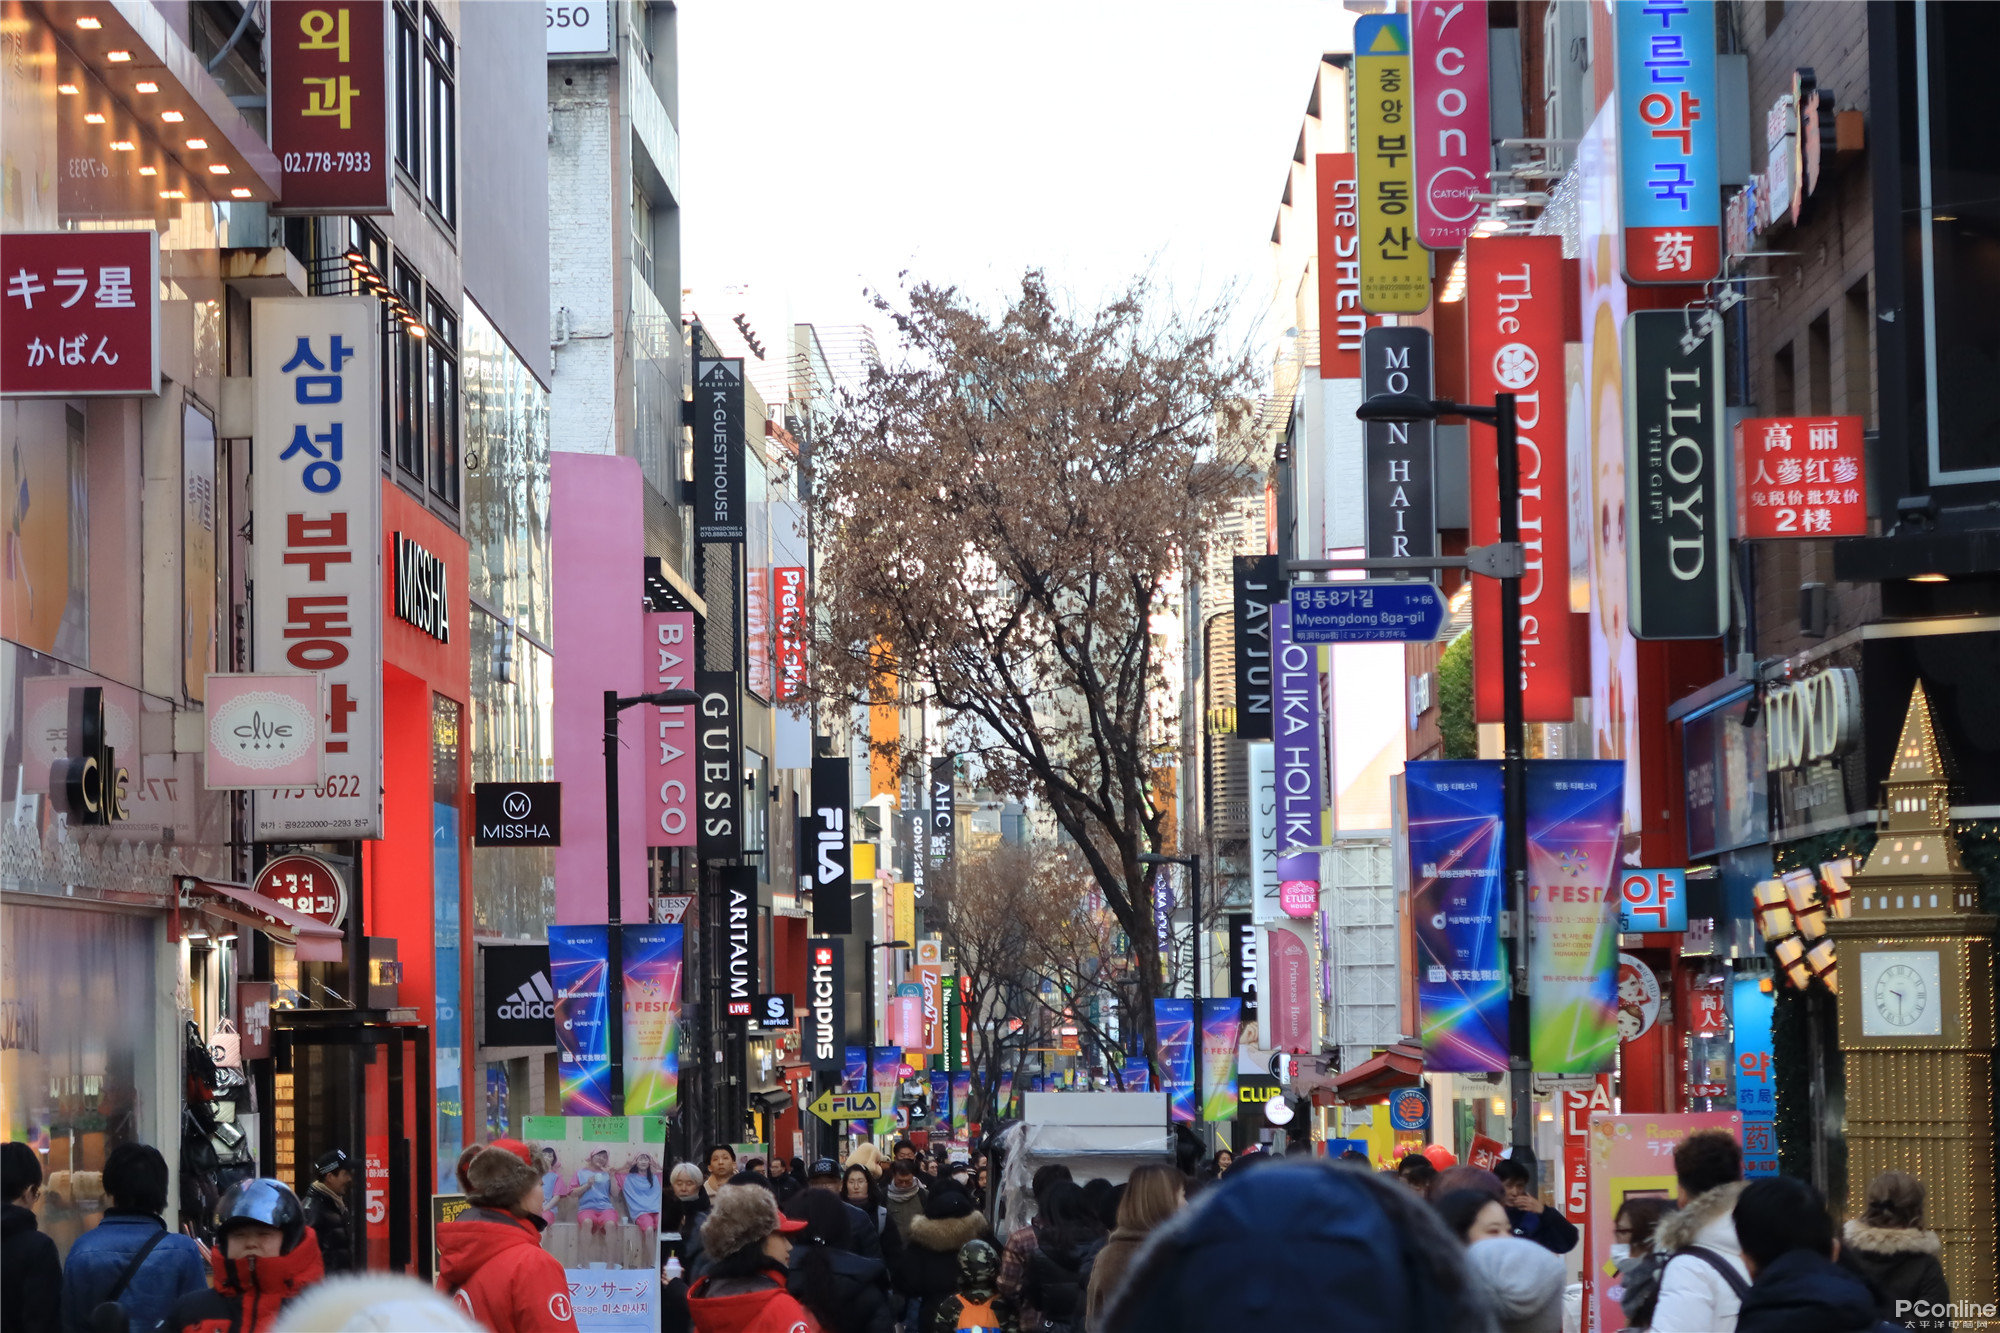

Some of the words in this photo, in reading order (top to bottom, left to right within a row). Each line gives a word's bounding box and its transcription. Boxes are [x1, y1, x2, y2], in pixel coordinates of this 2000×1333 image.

[298, 8, 360, 130] 외과
[284, 152, 372, 173] 02.778-7933
[1376, 68, 1412, 261] 중앙부동산
[1654, 231, 1694, 272] 药
[7, 266, 136, 310] キラ星
[1496, 263, 1533, 335] The
[27, 333, 119, 367] かばん
[1385, 347, 1411, 444] MON
[1762, 420, 1840, 452] 高丽
[713, 391, 728, 522] K-GUESTHOUSE
[1665, 366, 1706, 581] LLOYD
[1388, 460, 1412, 558] HAIR
[1775, 508, 1832, 533] 2楼
[397, 531, 450, 644] MISSHA
[1296, 588, 1374, 609] 명동8가길
[1296, 612, 1378, 627] Myeongdong
[1381, 611, 1425, 625] 8ga-gil
[1246, 580, 1271, 714] JAYJUN
[702, 692, 732, 837] GUESS
[660, 779, 687, 835] CO
[935, 781, 951, 828] AHC
[483, 824, 551, 839] MISSHA
[817, 807, 845, 885] FILA
[1286, 894, 1316, 903] ETUDE
[1622, 873, 1675, 929] 약
[729, 889, 750, 999] ARITAUM
[1290, 961, 1299, 1001] Princess
[729, 1004, 750, 1014] LIVE
[766, 997, 785, 1019] S
[813, 965, 833, 1060] swatch
[1291, 1006, 1300, 1038] House
[1739, 1051, 1771, 1084] 약
[832, 1096, 877, 1112] FILA
[1568, 1083, 1611, 1109] SA
[1743, 1125, 1770, 1150] 药
[567, 1281, 649, 1300] マッサージ
[602, 1302, 649, 1315] 미소마사지
